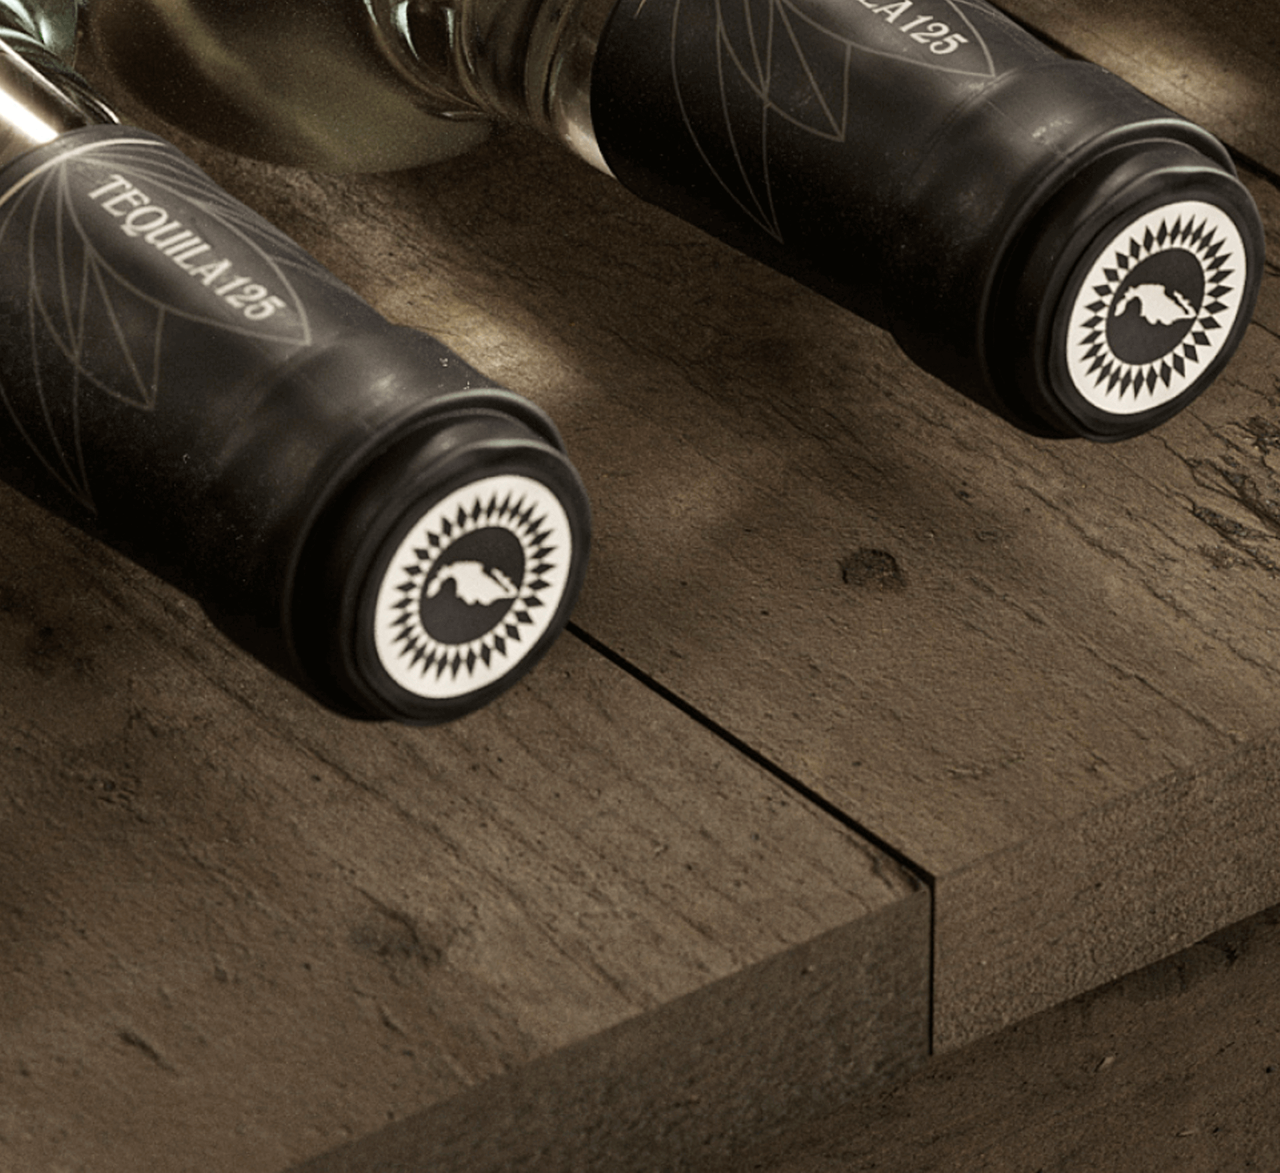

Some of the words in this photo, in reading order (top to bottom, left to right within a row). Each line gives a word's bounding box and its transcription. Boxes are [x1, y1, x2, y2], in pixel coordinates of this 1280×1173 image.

[899, 14, 968, 55] 125
[87, 173, 232, 286] TEQUILA
[214, 275, 287, 321] 125
